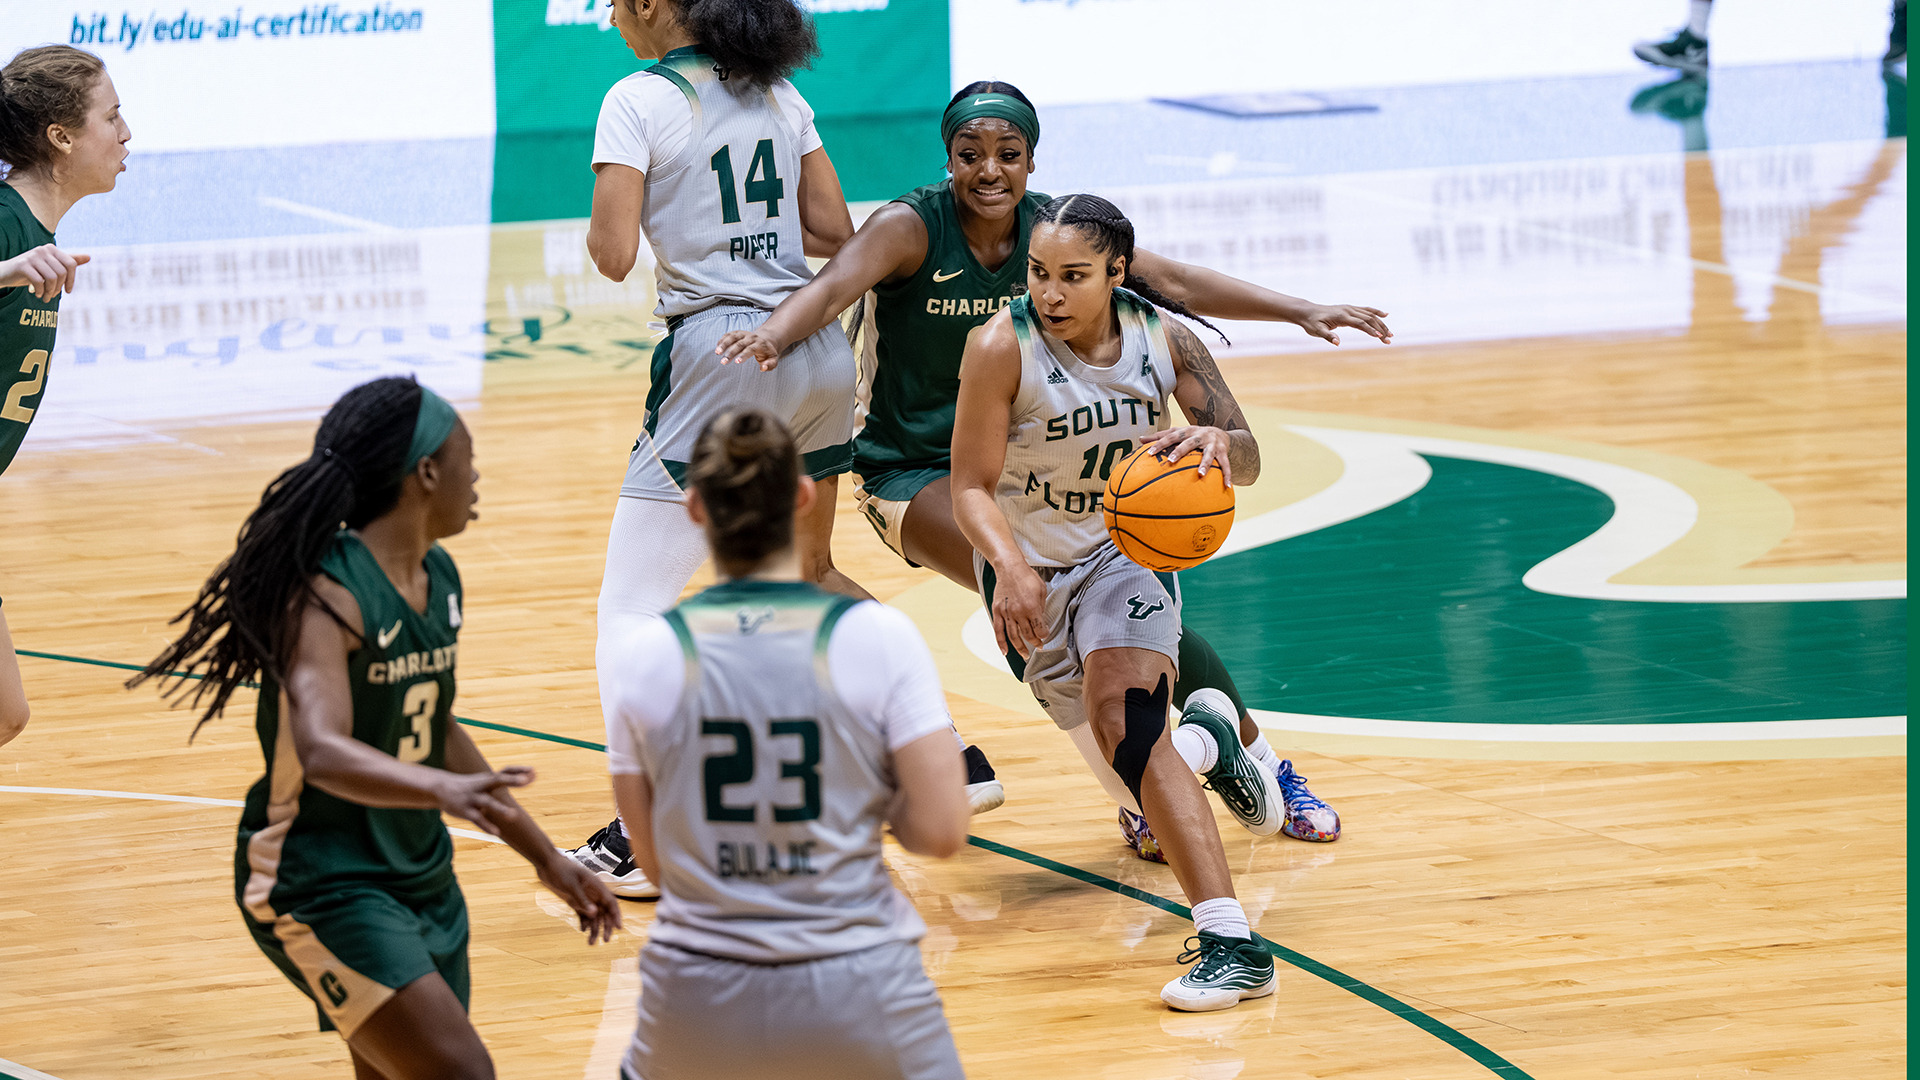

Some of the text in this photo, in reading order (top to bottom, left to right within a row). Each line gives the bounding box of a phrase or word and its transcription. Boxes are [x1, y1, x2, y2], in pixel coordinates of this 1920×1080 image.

[70, 2, 424, 51] bit.ly/edu-ai-certification
[710, 138, 784, 225] 14
[729, 231, 778, 261] PIPER
[926, 295, 1024, 316] CHARLO
[0, 348, 53, 424] 2
[1045, 398, 1161, 442] SOUTH
[1079, 439, 1133, 481] 10
[1024, 470, 1104, 514] FLOR
[397, 680, 440, 763] 3
[699, 717, 822, 823] 23
